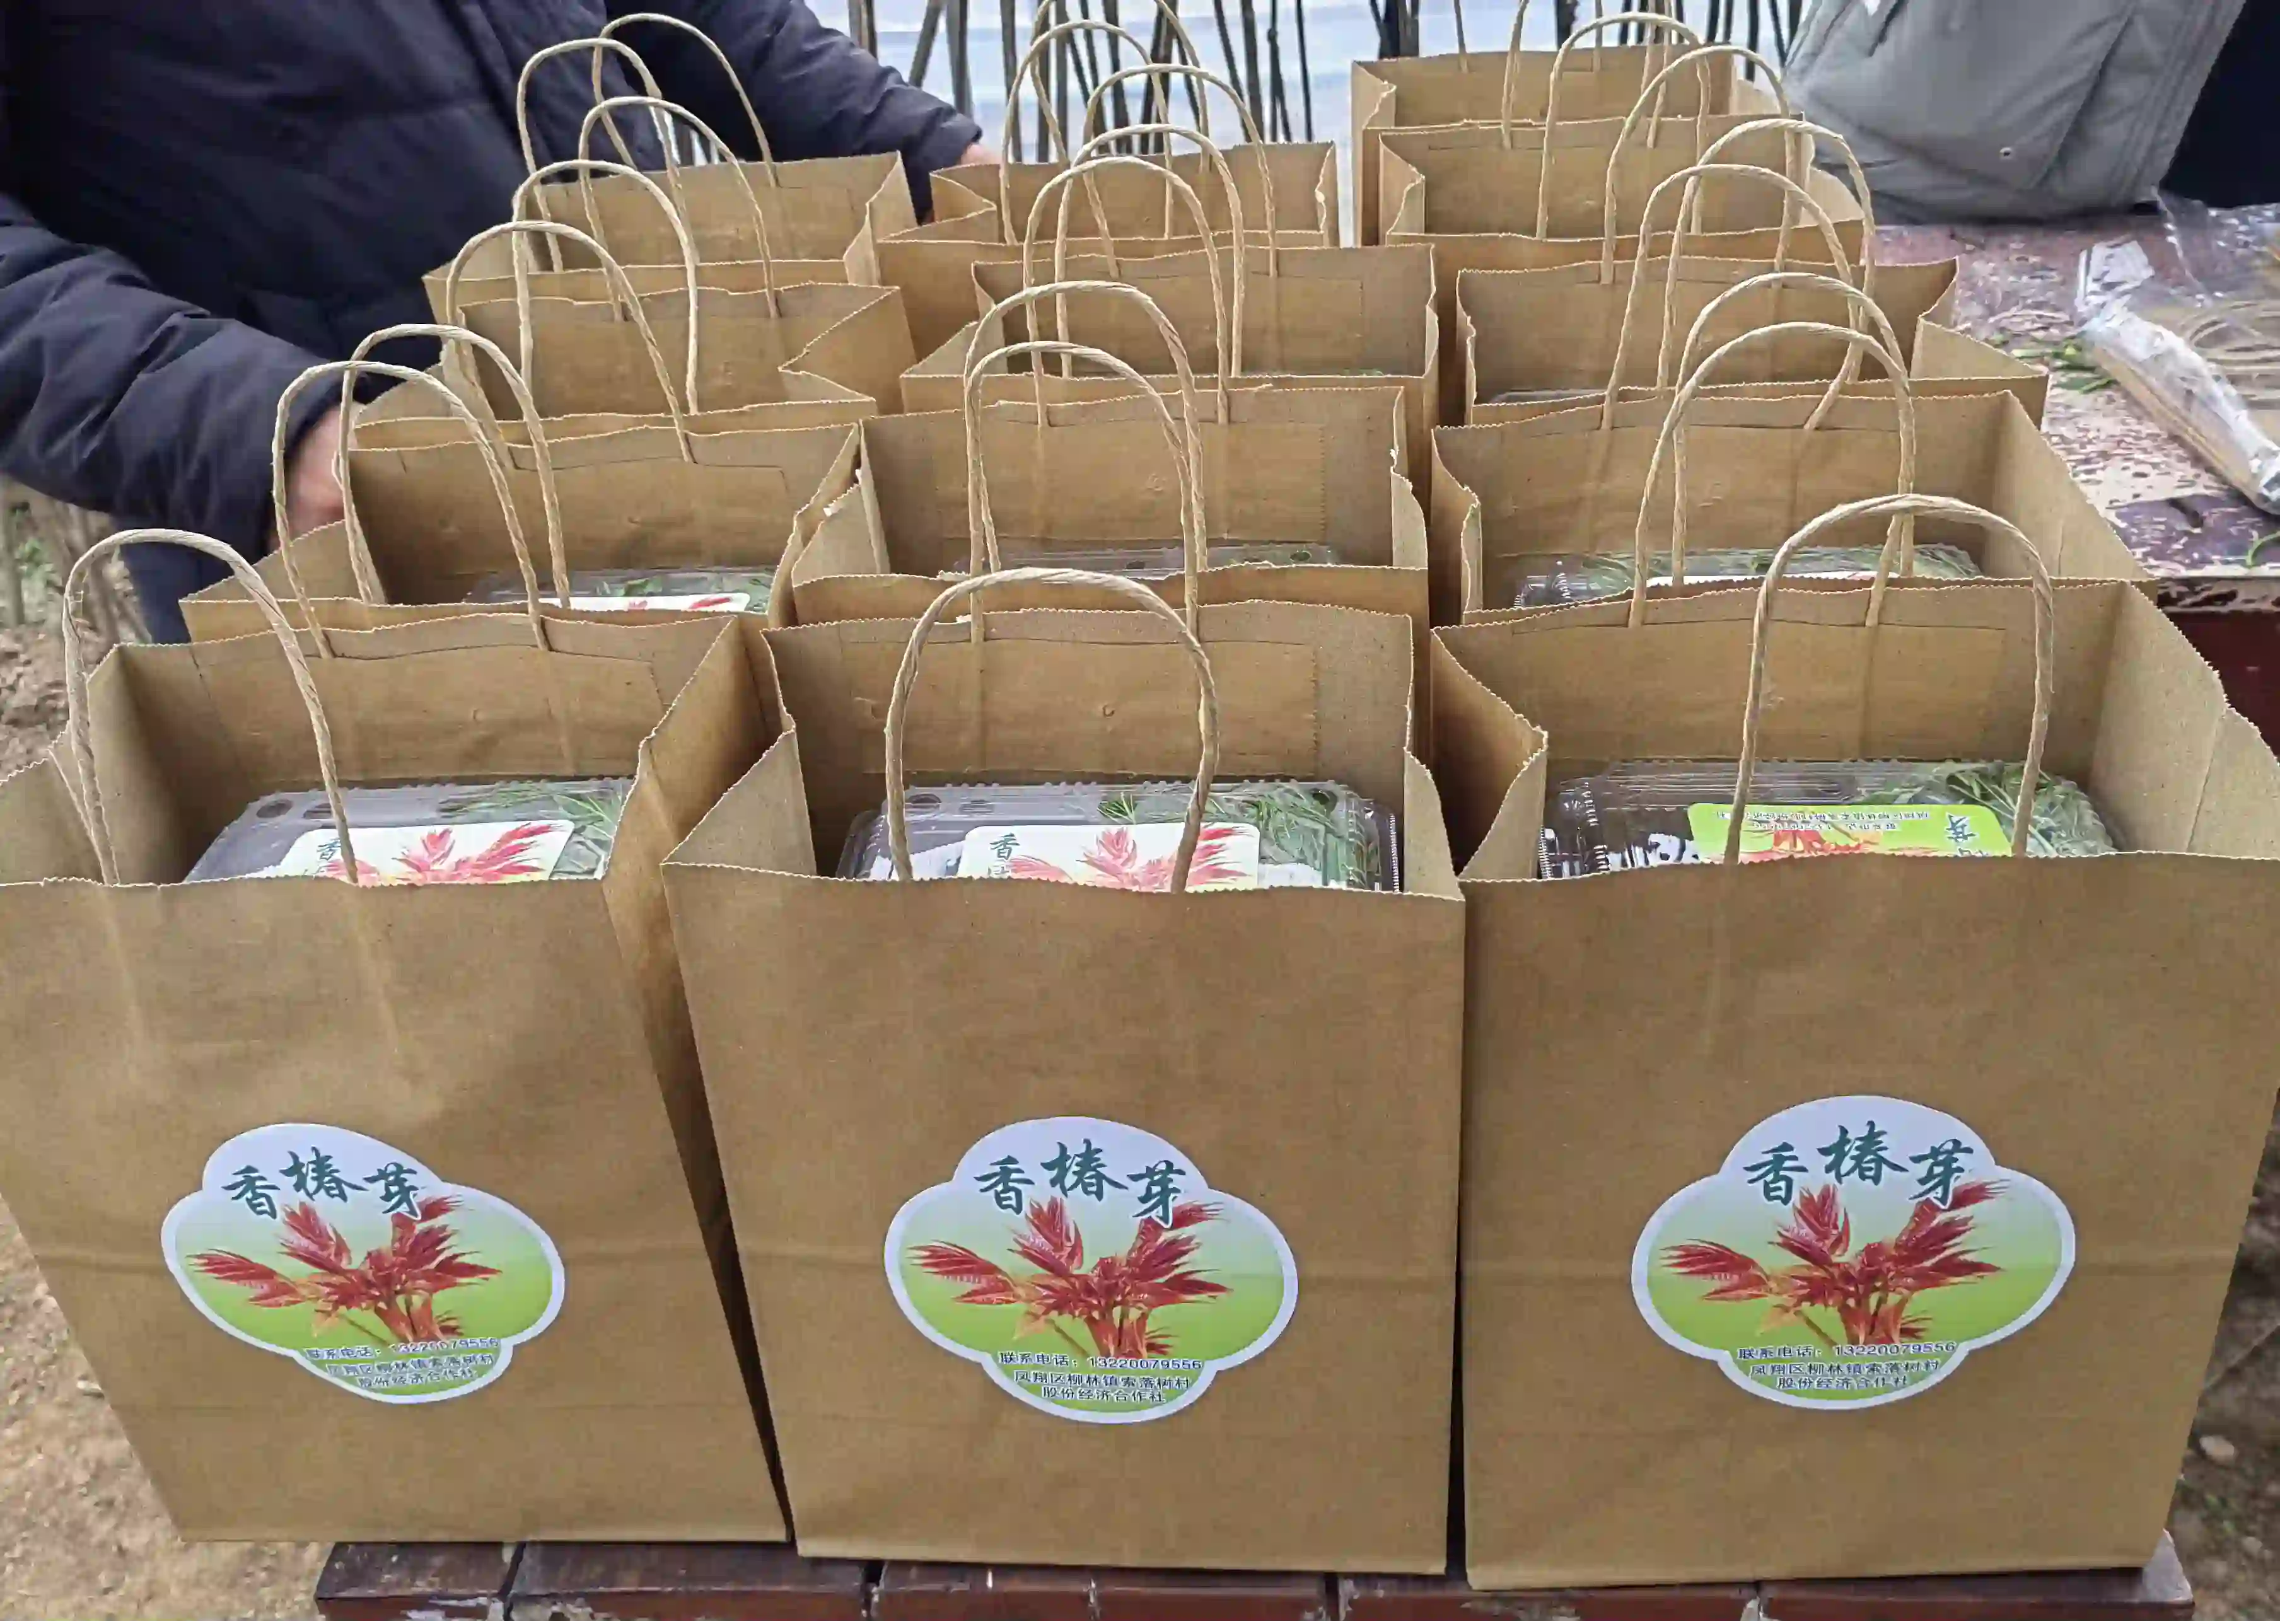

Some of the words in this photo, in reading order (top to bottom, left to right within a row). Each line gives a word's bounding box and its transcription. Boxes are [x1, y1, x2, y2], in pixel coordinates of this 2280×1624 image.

[222, 1147, 422, 1219] 香椿芽
[974, 1138, 1187, 1228] 香椿芽
[1743, 1120, 1974, 1210] 香椿芽
[1089, 1356, 1202, 1370] 13220079556
[1835, 1341, 1955, 1356] 13220079556
[1042, 1386, 1166, 1403] 股份经济合作社
